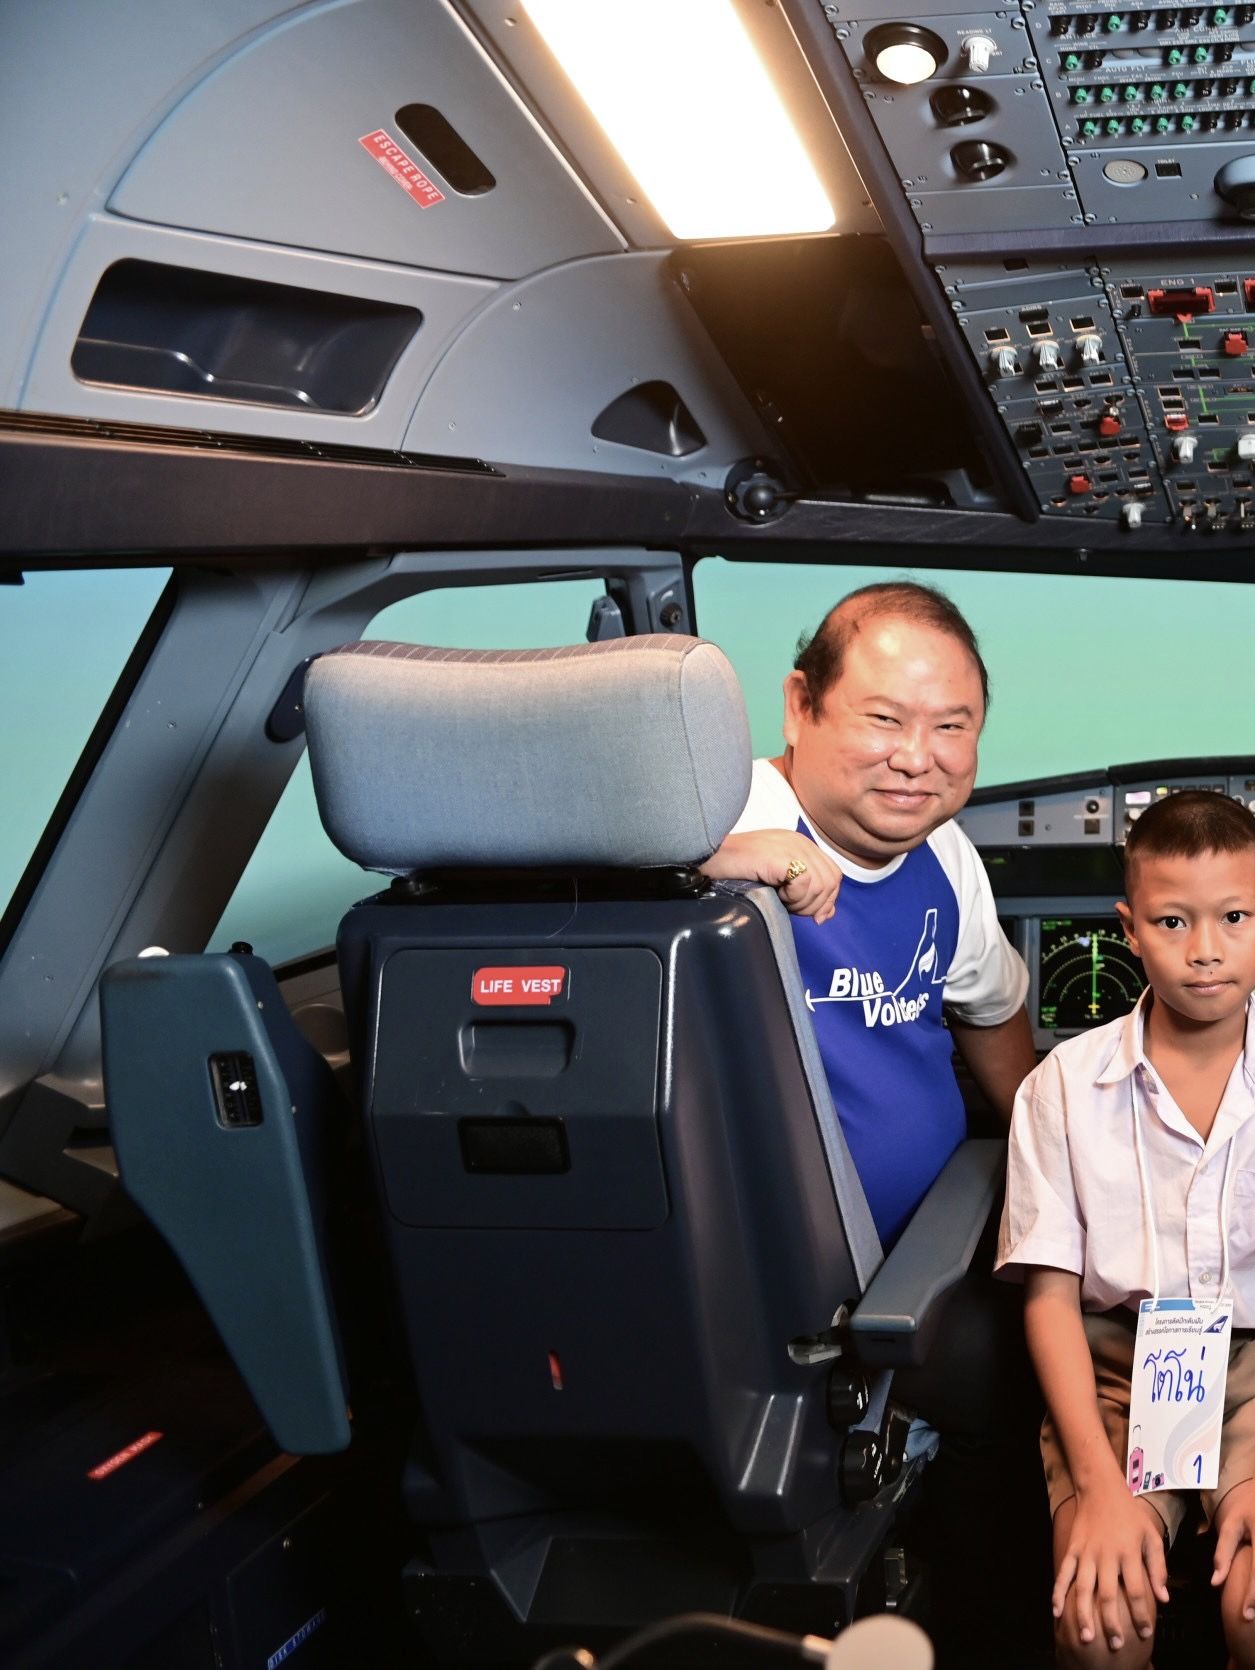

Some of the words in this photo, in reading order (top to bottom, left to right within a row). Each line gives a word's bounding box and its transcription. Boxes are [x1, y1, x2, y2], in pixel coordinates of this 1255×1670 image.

[373, 134, 415, 174] ESCAPE
[410, 173, 440, 200] ROPE
[1160, 279, 1185, 287] ENG
[480, 979, 513, 993] LIFE
[521, 979, 562, 993] VEST
[828, 967, 885, 997] Blue
[1143, 1346, 1206, 1404] โตโน่
[1193, 1454, 1203, 1484] 1
